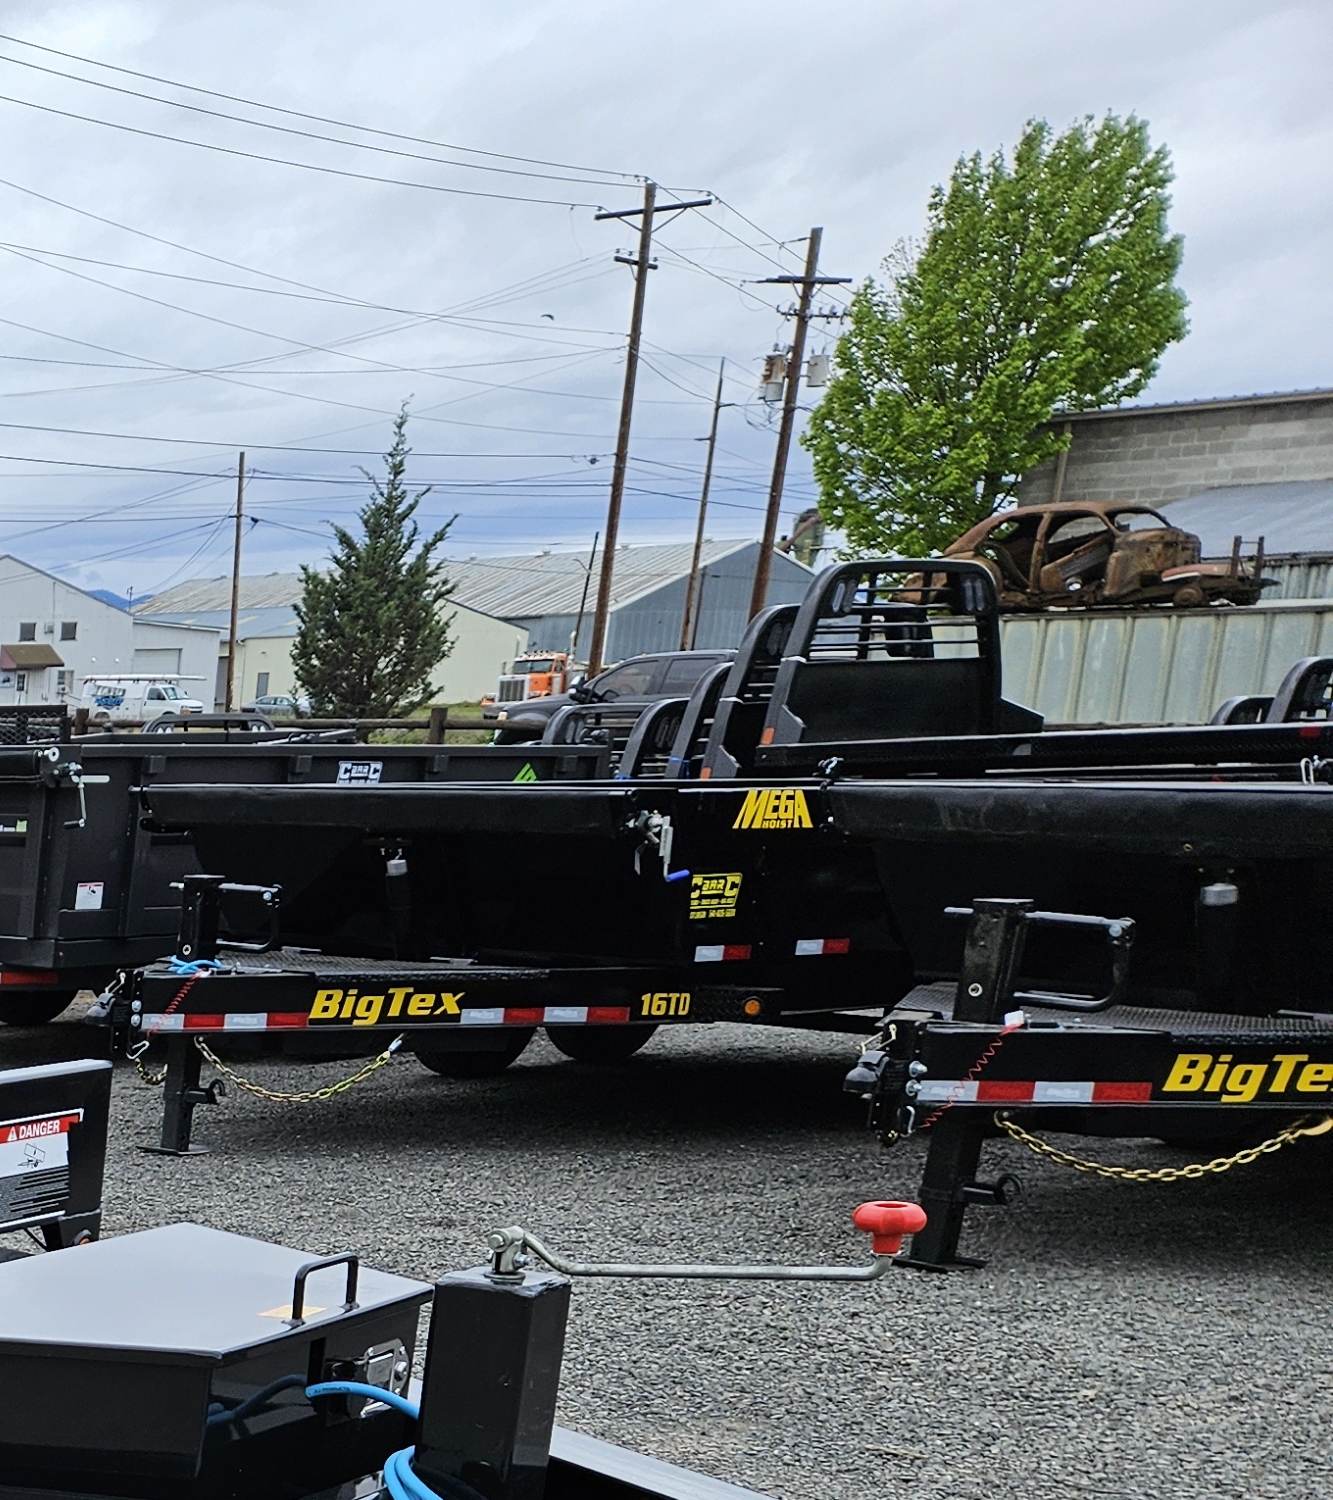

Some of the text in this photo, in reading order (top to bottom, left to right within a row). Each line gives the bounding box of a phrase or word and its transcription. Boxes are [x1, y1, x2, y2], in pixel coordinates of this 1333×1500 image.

[732, 789, 814, 829] MEGA
[763, 820, 794, 829] HOIST
[702, 879, 725, 891] BAR
[724, 876, 740, 897] C
[309, 988, 465, 1026] BigTex
[641, 993, 690, 1016] 16TD
[19, 1119, 60, 1139] DANGER
